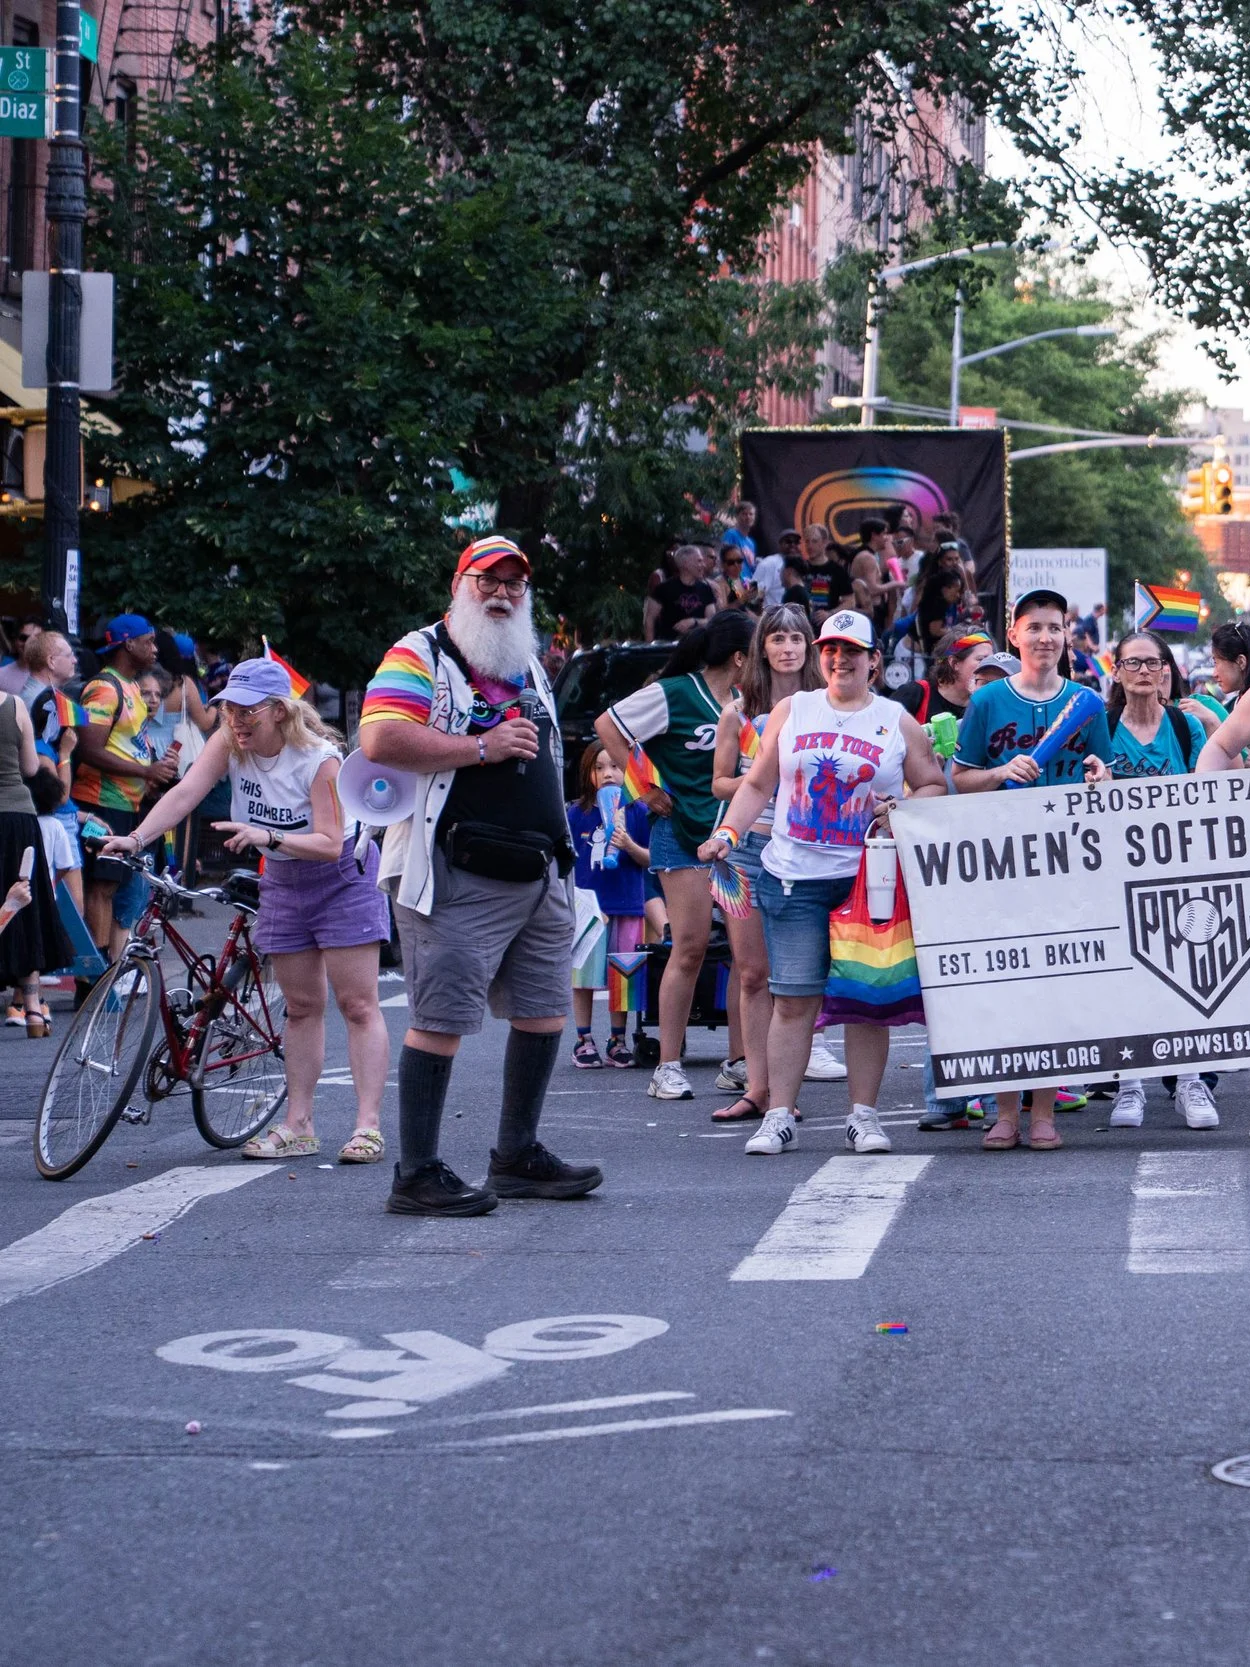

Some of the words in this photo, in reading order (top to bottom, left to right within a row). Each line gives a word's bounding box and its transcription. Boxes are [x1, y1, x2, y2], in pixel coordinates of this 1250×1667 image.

[15, 51, 31, 69] St
[0, 97, 37, 119] Diaz
[792, 732, 839, 754] NEW
[840, 734, 885, 768] YORK
[987, 721, 1087, 759] Rels
[240, 778, 262, 798] THIS
[1065, 780, 1219, 816] PROSPECT
[914, 822, 1102, 887] WOMEN'S
[938, 953, 978, 976] EST.
[985, 947, 1031, 972] 1981
[1045, 939, 1106, 967] BKLYN
[940, 1045, 1100, 1081] WWW.PPWSL.ORG
